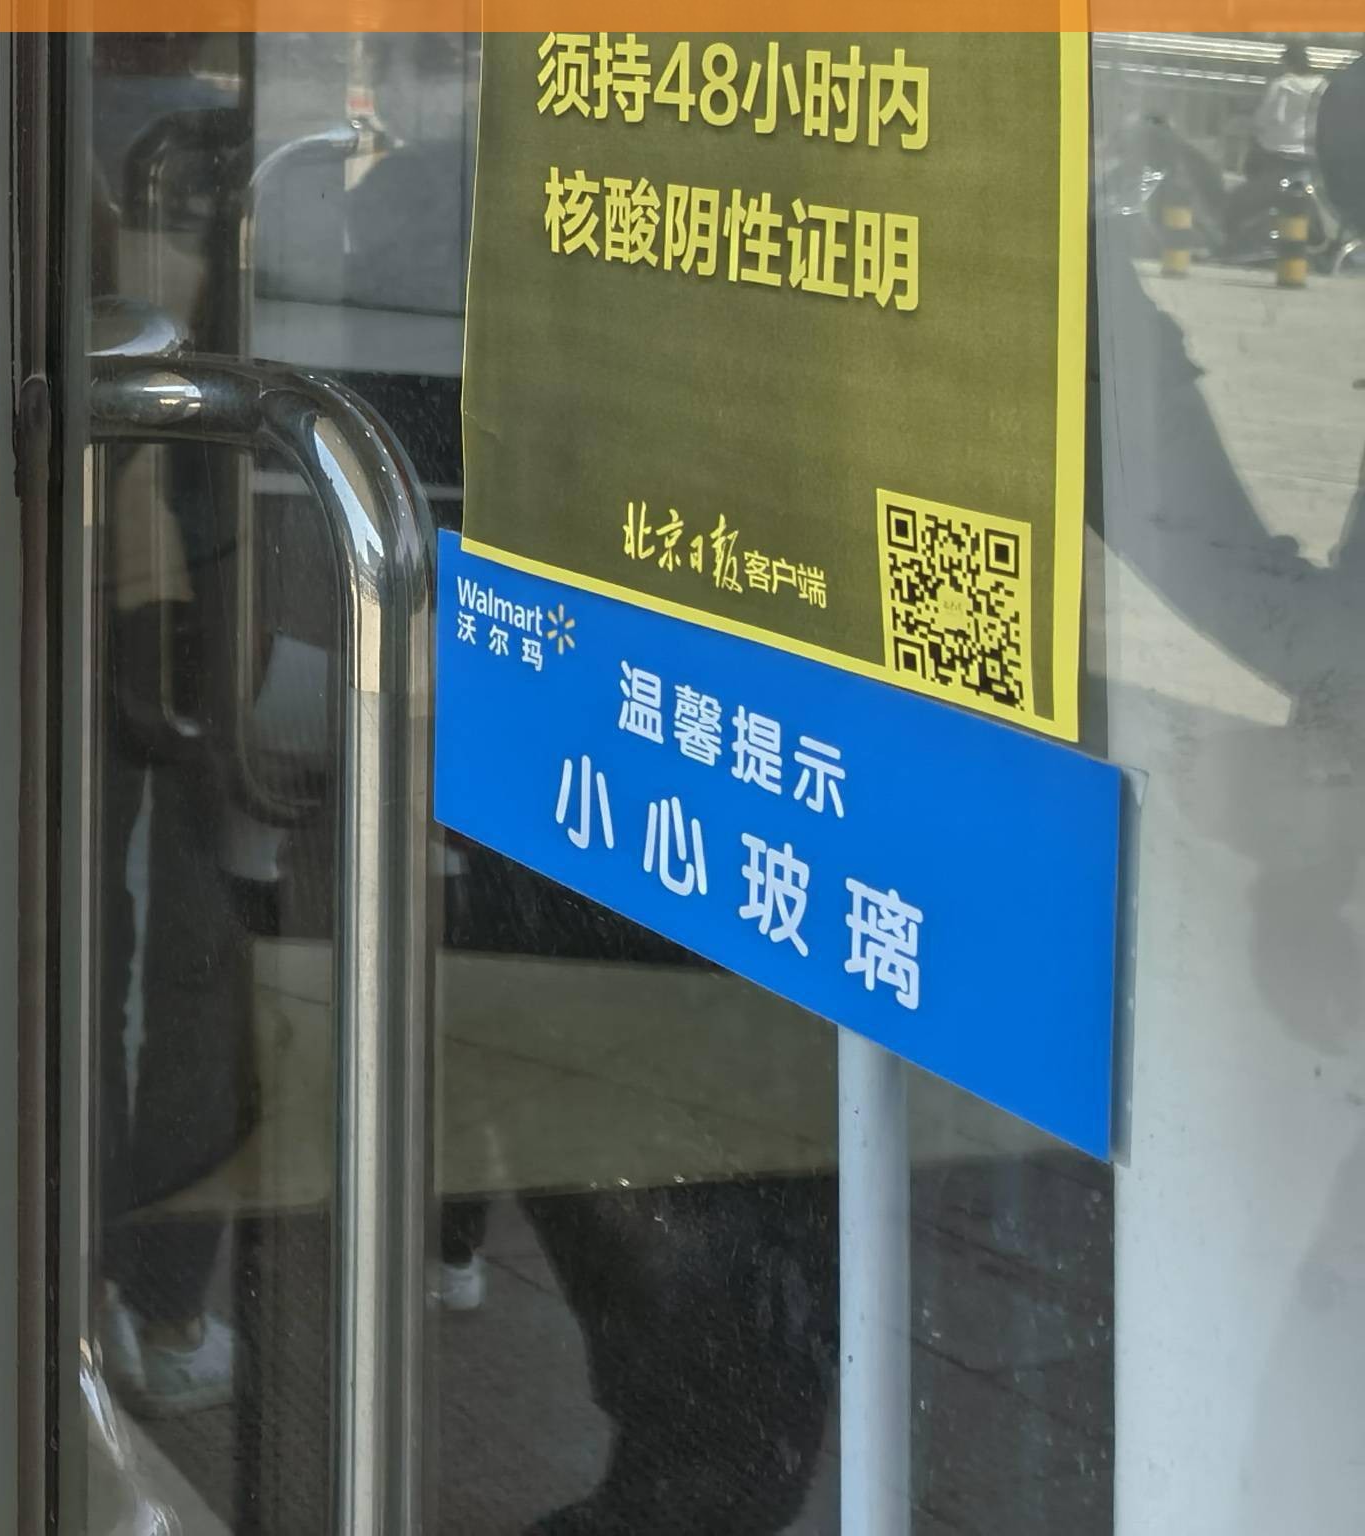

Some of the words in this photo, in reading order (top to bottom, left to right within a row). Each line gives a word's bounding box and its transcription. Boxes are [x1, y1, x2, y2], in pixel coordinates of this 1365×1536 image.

[535, 32, 931, 152] 须持48小时内
[543, 166, 921, 313] 核酸阴性证明
[456, 575, 543, 637] Walmart
[456, 610, 544, 672] 沃尔玛
[617, 658, 847, 819] 温馨提示
[554, 754, 925, 1011] 小心玻璃
